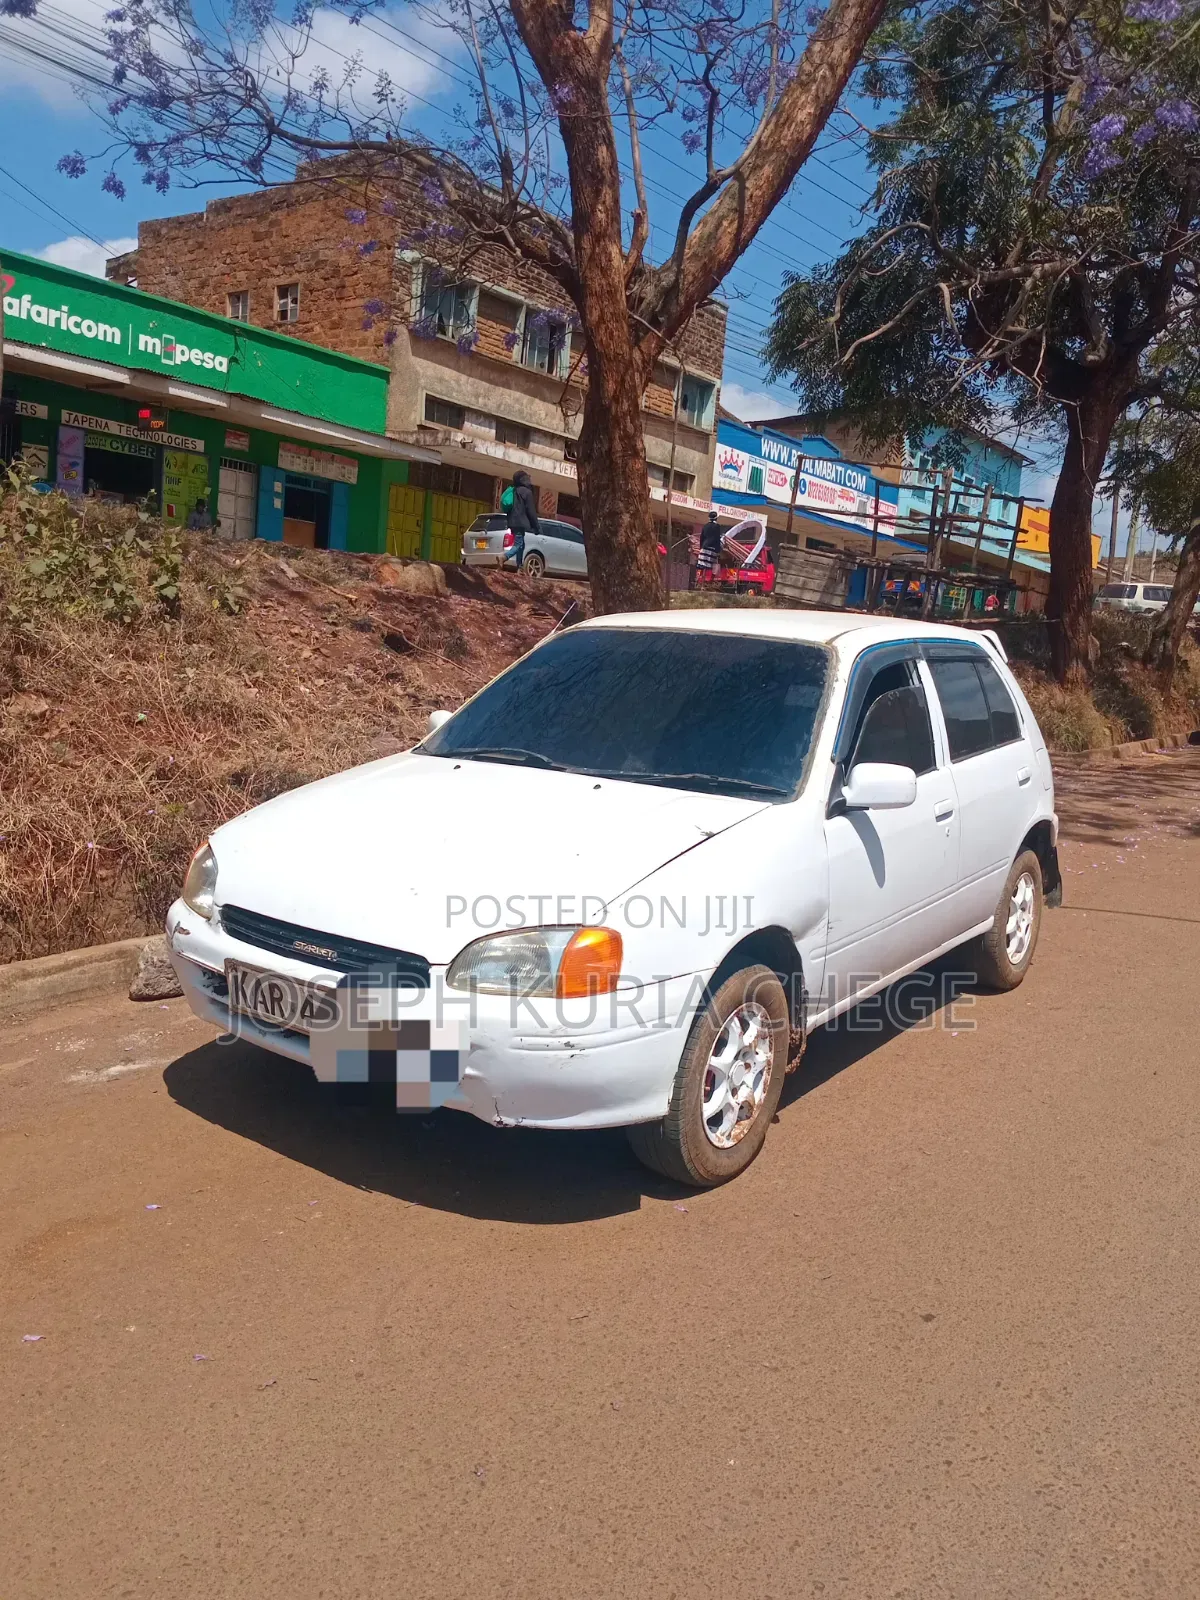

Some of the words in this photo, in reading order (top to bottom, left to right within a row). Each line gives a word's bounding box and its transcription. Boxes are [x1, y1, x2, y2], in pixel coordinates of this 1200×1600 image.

[65, 411, 110, 431] JAPENA
[117, 423, 197, 450] TECHNOLOGIES
[110, 438, 156, 459] CYBER
[294, 940, 336, 960] STARLET
[232, 971, 287, 1021] KAR
